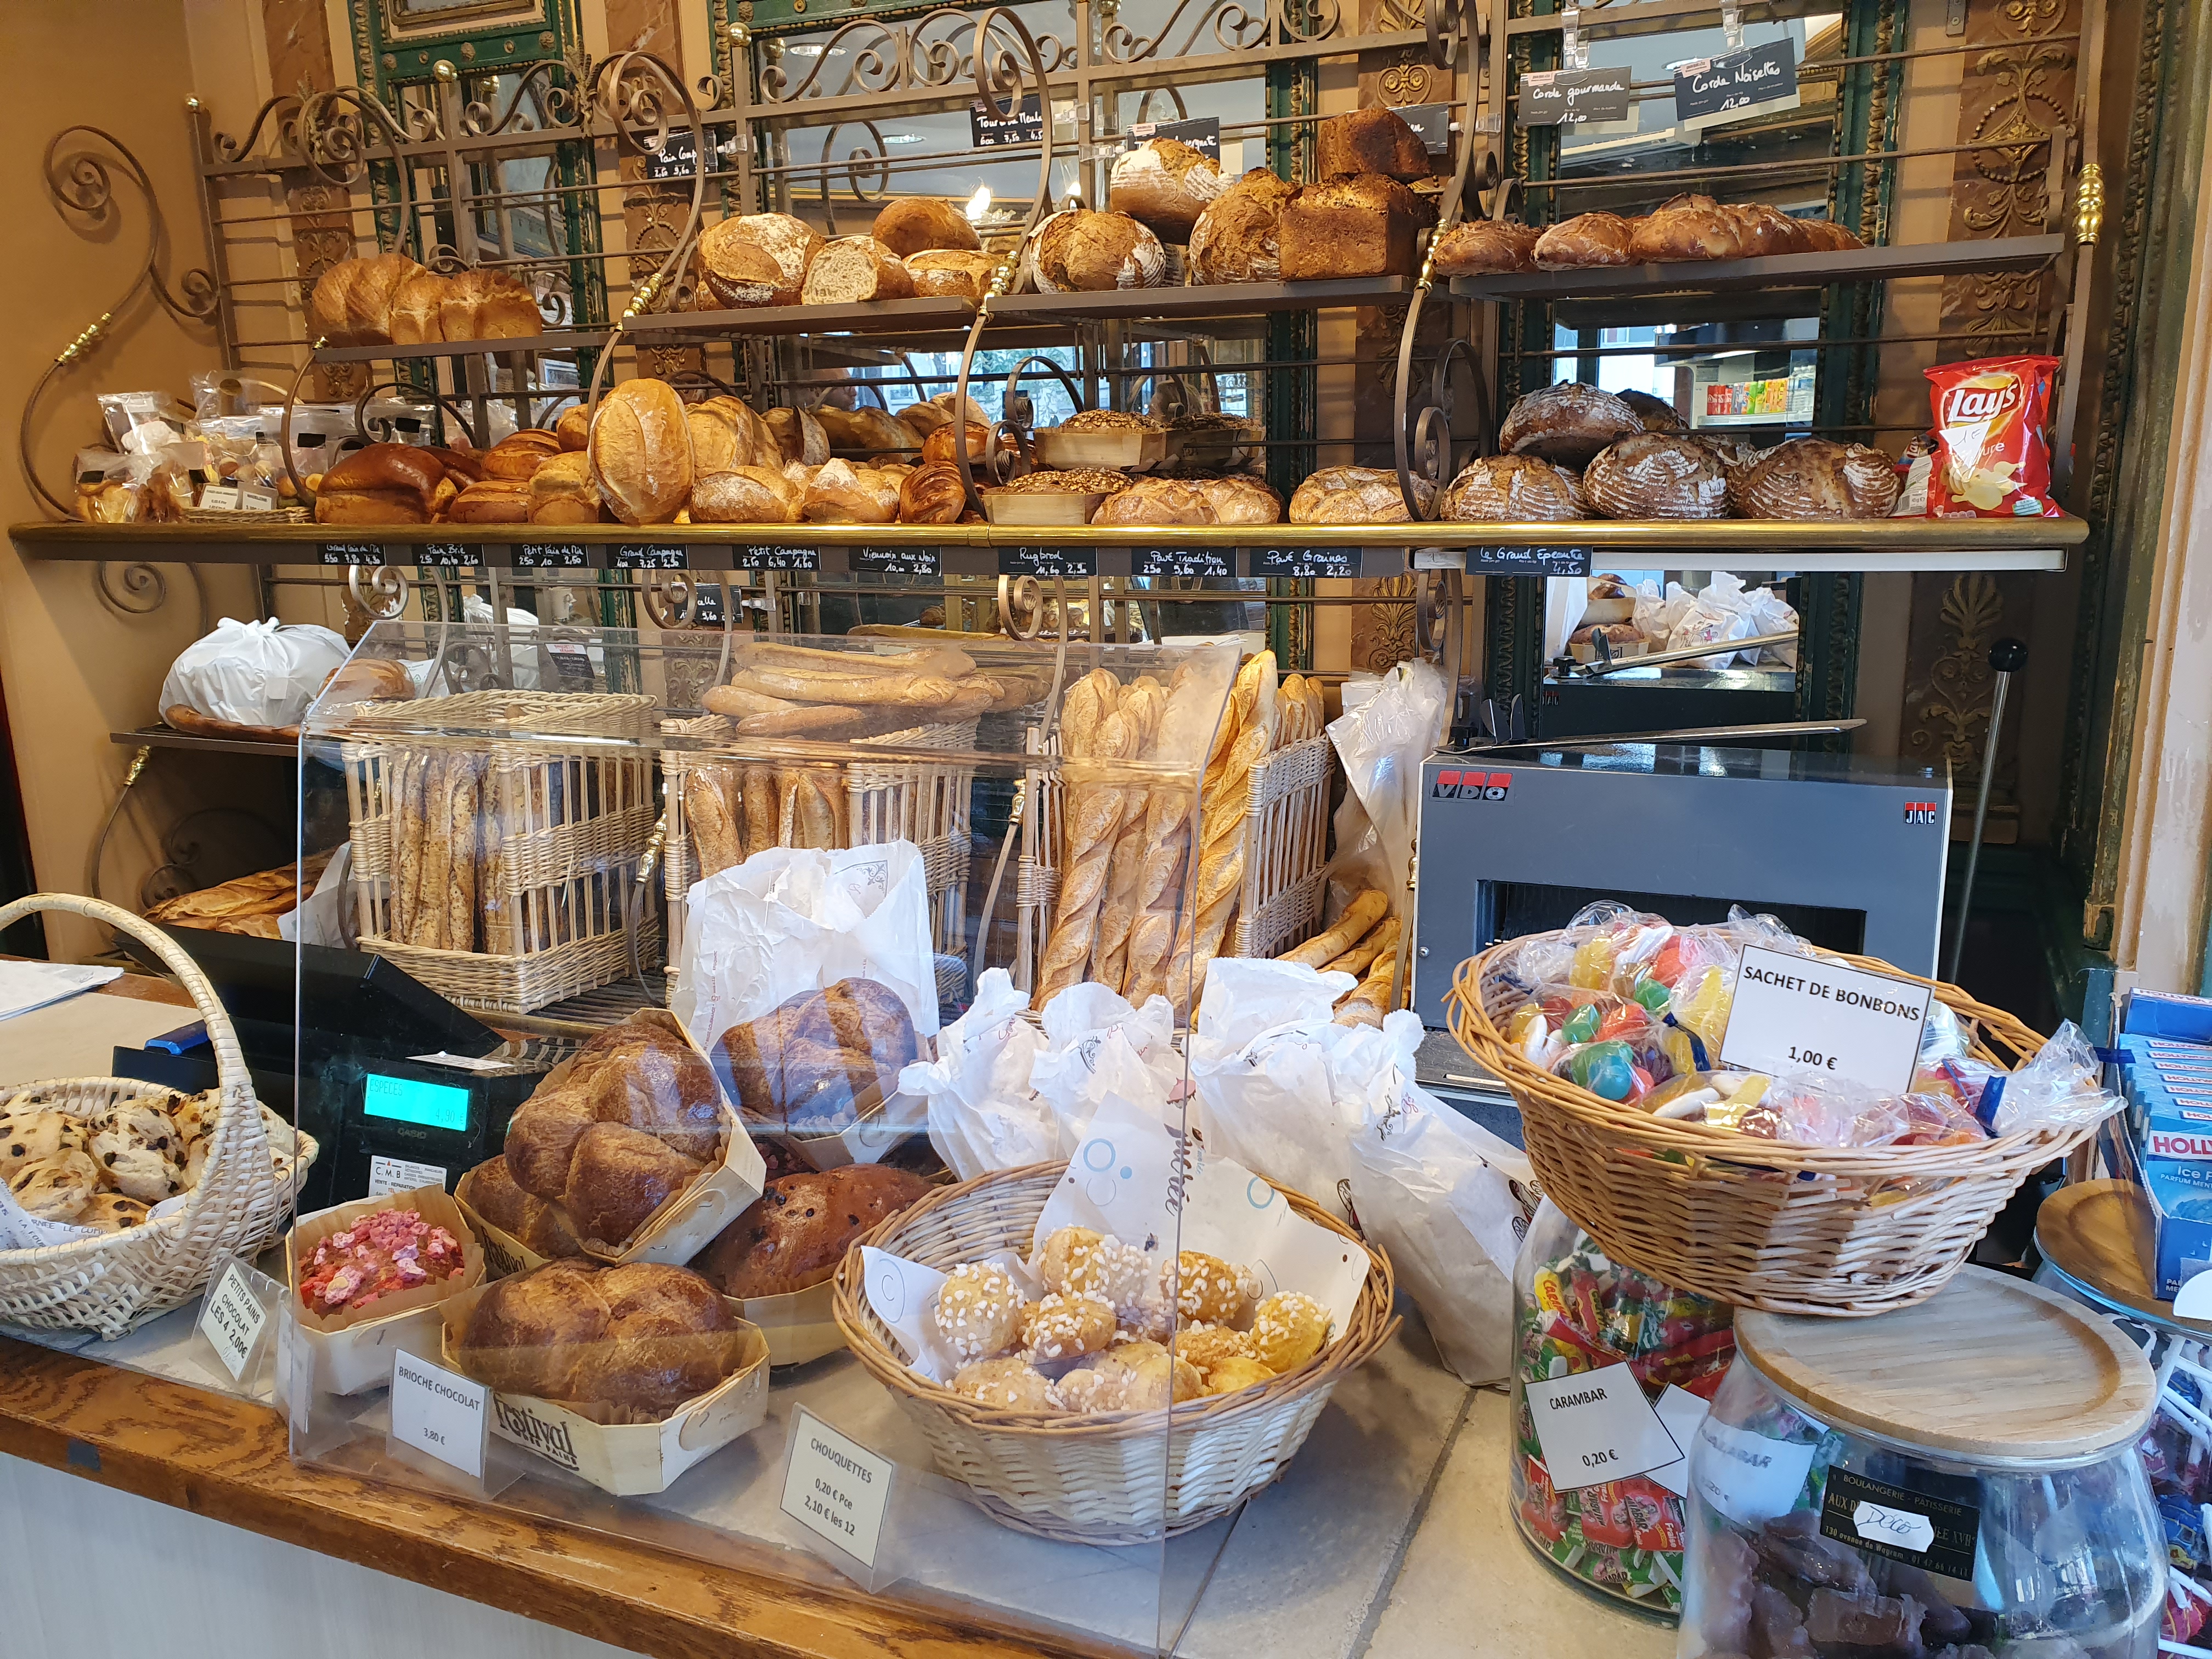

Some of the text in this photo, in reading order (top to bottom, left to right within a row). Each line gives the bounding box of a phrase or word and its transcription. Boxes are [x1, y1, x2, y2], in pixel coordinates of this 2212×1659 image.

[1692, 74, 1730, 93] Corde
[1533, 81, 1625, 106] Corde gourmande
[1720, 97, 1751, 111] 12,00
[1556, 112, 1588, 124] 12,00
[1030, 130, 1043, 140] 4,5
[620, 546, 643, 557] Grand
[1150, 550, 1223, 566] Pavé Tradition
[1266, 550, 1295, 564] Pavé
[1497, 547, 1531, 560] Grand
[1143, 565, 1161, 574] 250
[1293, 566, 1352, 578] 8,80 2,20
[1905, 810, 1936, 823] JAC
[1743, 966, 1921, 1022] SACHET DE BONBONS
[1788, 1046, 1838, 1070] 1,00 €
[369, 1079, 403, 1096] ESPECES
[435, 1108, 465, 1125] 4,90 €
[2160, 1173, 2191, 1186] PARFUM
[2177, 1166, 2201, 1179] Ice
[227, 1273, 260, 1324] PETITS PAINS
[210, 1300, 230, 1331] LES 4
[222, 1294, 250, 1336] CHOCOLAT
[398, 1365, 481, 1411] BRIOCHE CHOCOLAT
[1549, 1387, 1608, 1410] CARAMBAR
[810, 1437, 873, 1483] CHOUQUETTES
[1581, 1449, 1618, 1468] 0,20 €
[815, 1477, 853, 1510] 0,20 € Pce
[1843, 1474, 1905, 1501] BOULANGERIE
[1828, 1492, 1848, 1510] AUX
[804, 1495, 855, 1536] 2,10 € les 12
[1825, 1525, 1837, 1537] 130
[1839, 1532, 1863, 1545] avenue
[1865, 1539, 1874, 1549] de
[1876, 1543, 1904, 1559] Wagram
